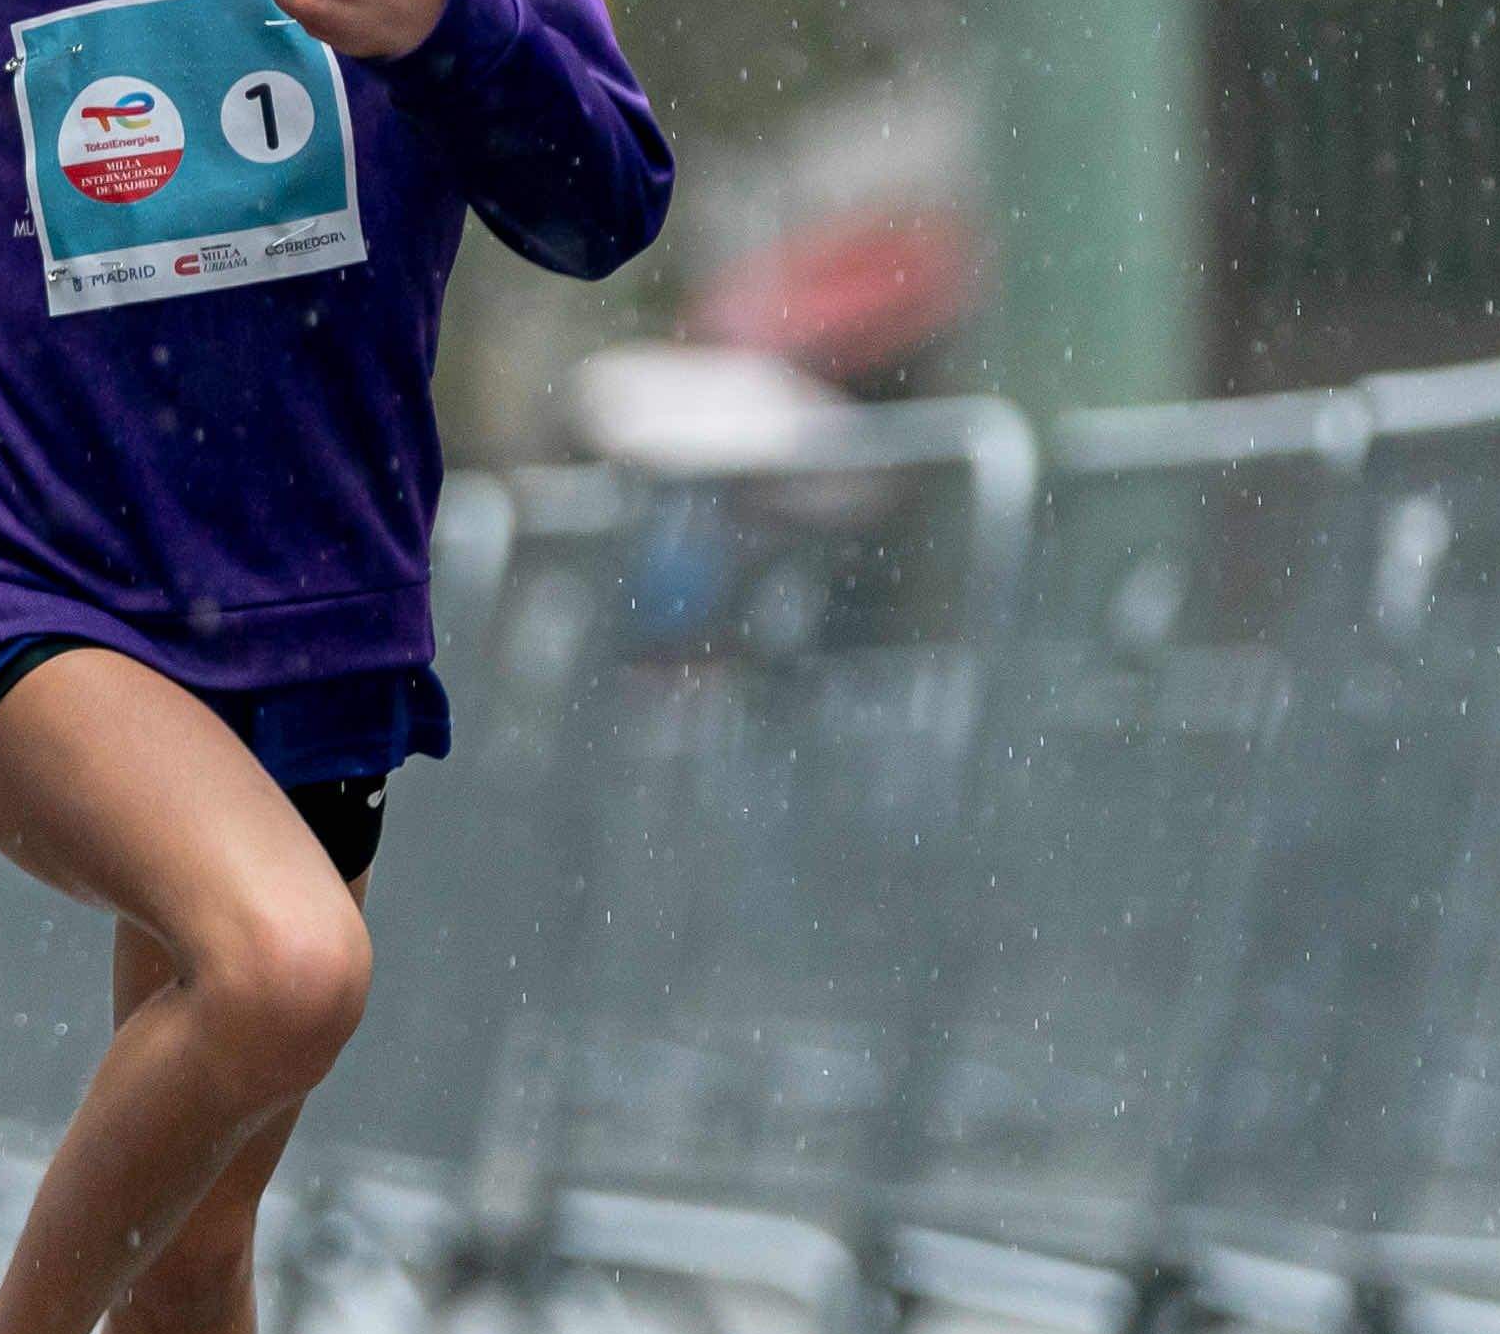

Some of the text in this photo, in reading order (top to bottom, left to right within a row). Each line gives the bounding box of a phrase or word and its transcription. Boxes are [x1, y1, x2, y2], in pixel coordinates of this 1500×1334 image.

[245, 83, 279, 150] 1
[84, 135, 160, 153] TotalEnergies
[105, 158, 142, 171] MILLA
[114, 178, 159, 193] MADRID
[201, 248, 241, 262] MILLA
[91, 264, 156, 287] MADRID
